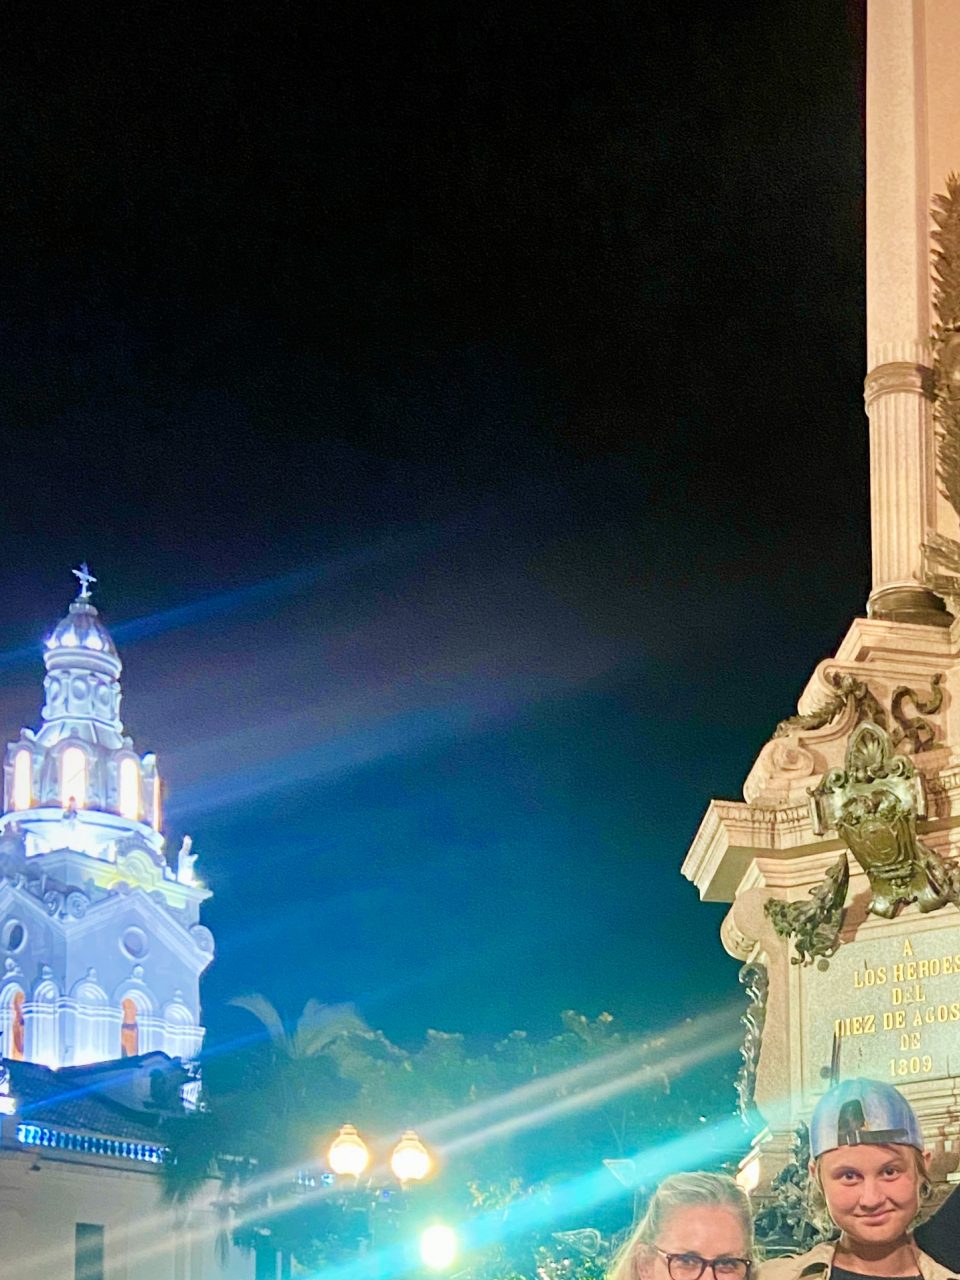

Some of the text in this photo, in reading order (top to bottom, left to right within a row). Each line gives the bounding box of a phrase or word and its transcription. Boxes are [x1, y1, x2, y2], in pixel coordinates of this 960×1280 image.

[902, 938, 913, 957] A
[853, 966, 887, 988] LOS
[891, 984, 925, 1006] DEL
[834, 1014, 876, 1038] DIEZ
[883, 1010, 906, 1030] DE
[900, 1032, 921, 1051] DE
[888, 1055, 932, 1077] 1809
